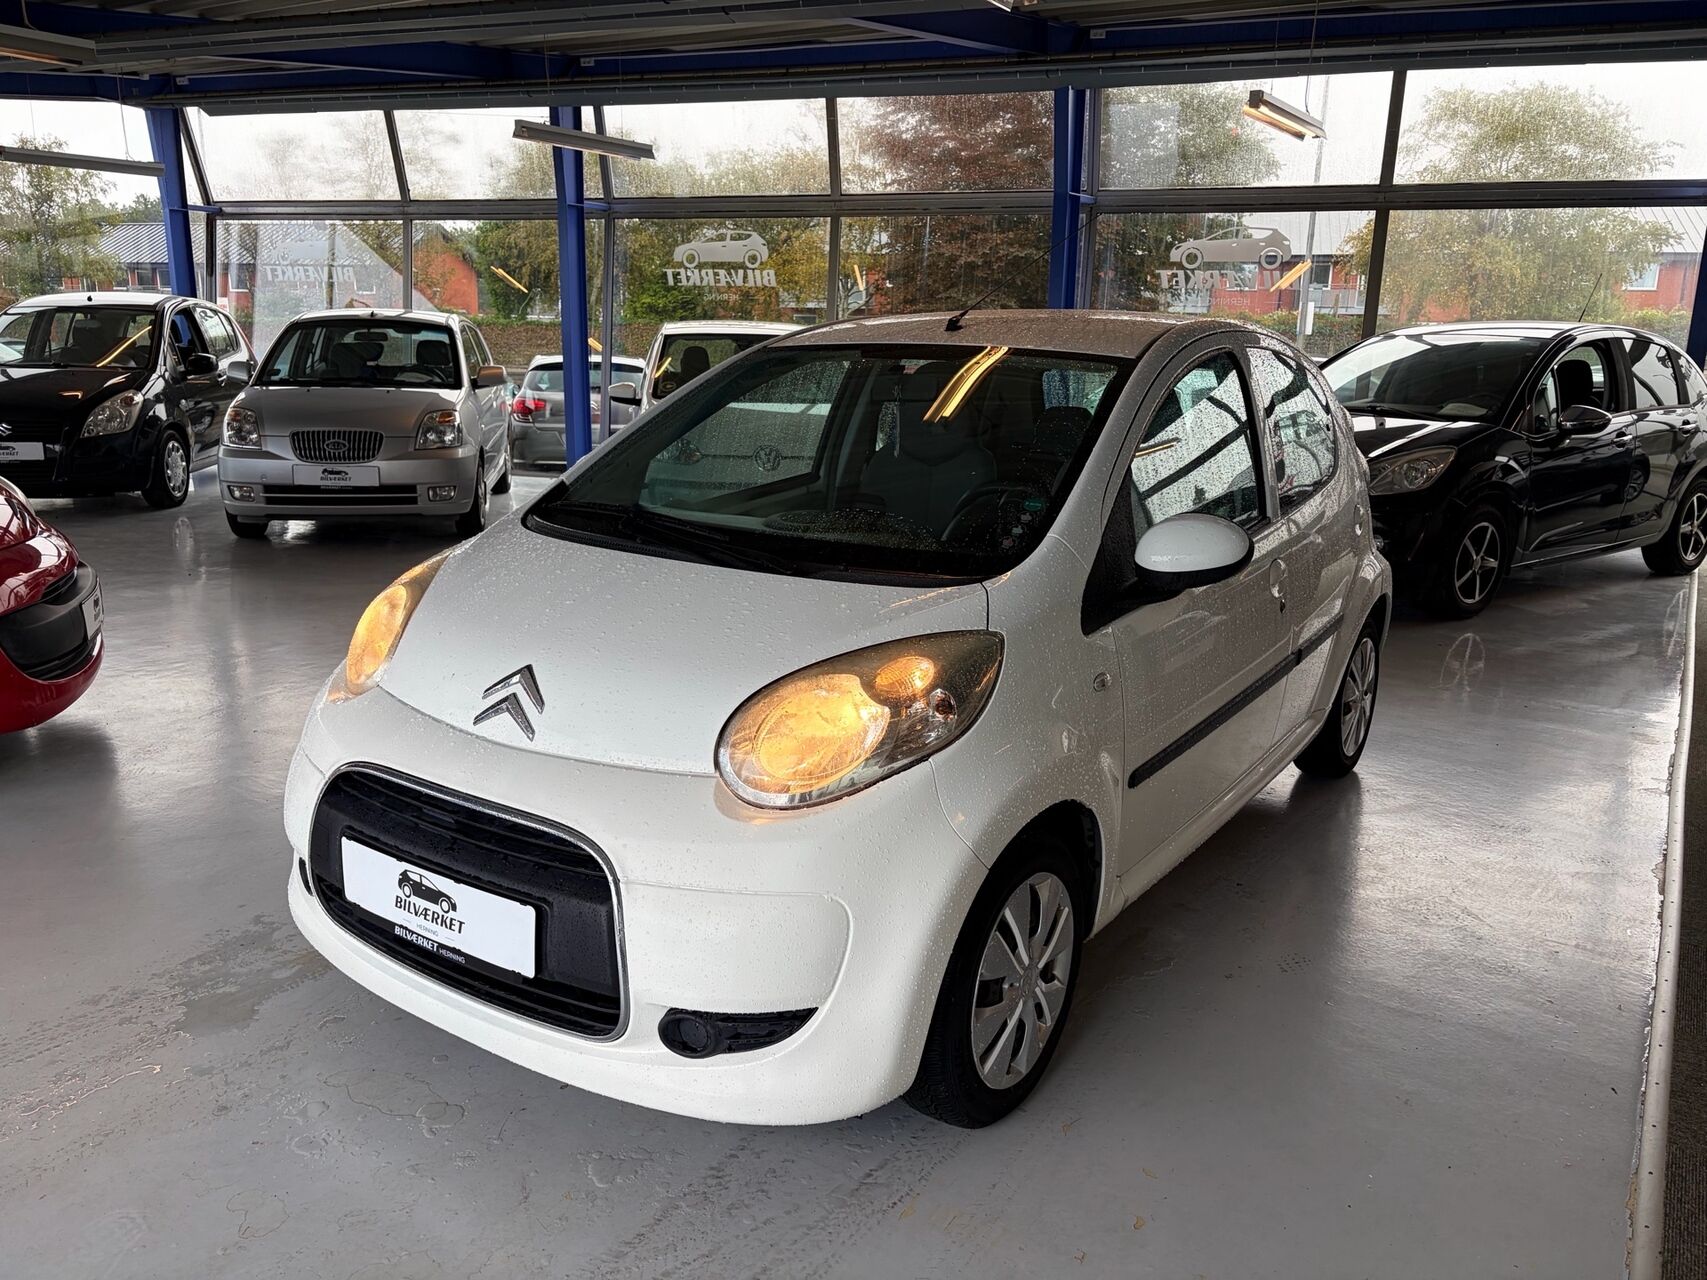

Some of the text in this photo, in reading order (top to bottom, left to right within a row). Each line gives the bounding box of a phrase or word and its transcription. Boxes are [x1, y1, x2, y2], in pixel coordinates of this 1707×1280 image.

[395, 894, 466, 935] BILVÆRKET
[416, 922, 440, 938] HERNING
[394, 924, 466, 965] BILVÆRKET HERNING
